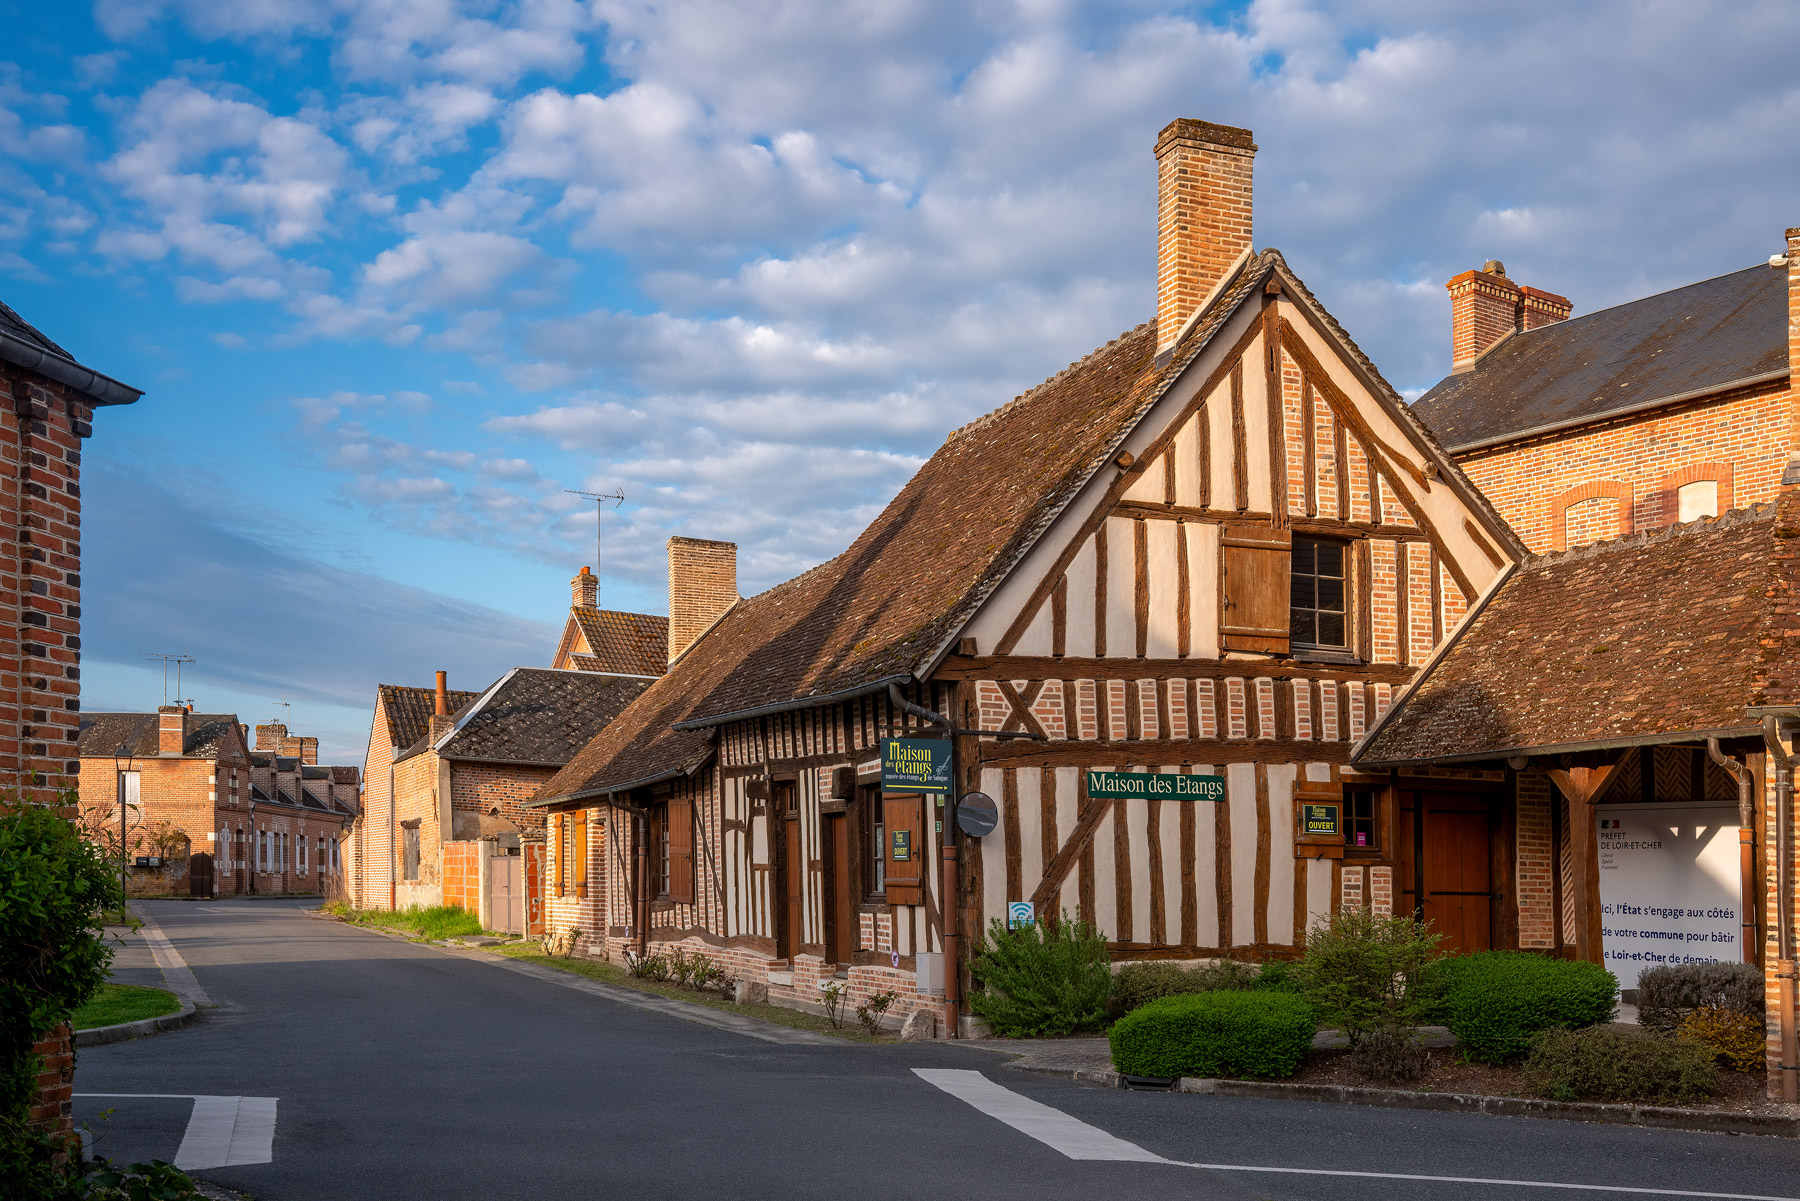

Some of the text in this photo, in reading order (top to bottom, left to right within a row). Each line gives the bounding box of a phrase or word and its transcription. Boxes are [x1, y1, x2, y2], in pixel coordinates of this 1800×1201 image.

[889, 740, 931, 761] Maison
[886, 760, 894, 768] des
[1090, 773, 1223, 799] Maison des Etangs
[1309, 821, 1334, 829] OUVERT
[1601, 831, 1626, 839] PRÉFET
[1612, 841, 1663, 849] LOIR-ET-CHER
[1601, 904, 1614, 915] Ici,
[1687, 909, 1704, 918] aux
[1707, 907, 1734, 918] côtés
[1601, 926, 1734, 943] de votre commune pour bâtir
[1612, 950, 1666, 962] Loir-et-Cher
[1669, 953, 1681, 963] de
